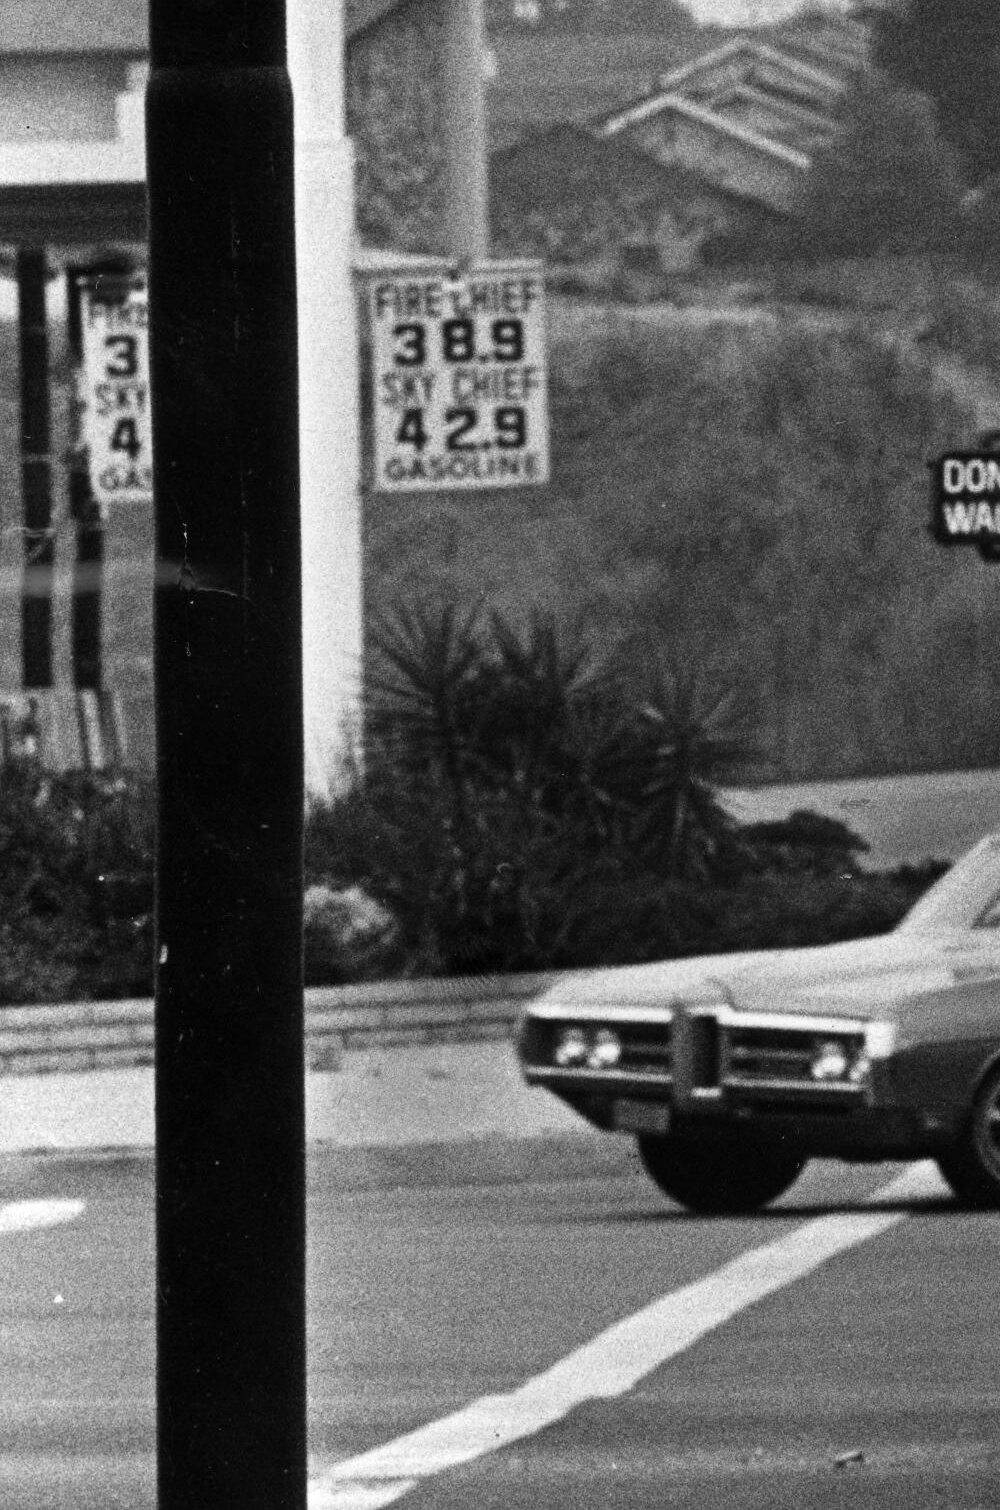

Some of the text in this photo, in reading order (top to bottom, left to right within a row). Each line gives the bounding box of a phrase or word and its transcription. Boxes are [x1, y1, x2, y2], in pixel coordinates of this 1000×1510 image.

[374, 283, 441, 318] FIRE
[392, 318, 524, 367] 38.9
[382, 367, 540, 407] SKY CHIEF
[396, 407, 526, 452] 42.9
[385, 452, 540, 480] GASOLINE
